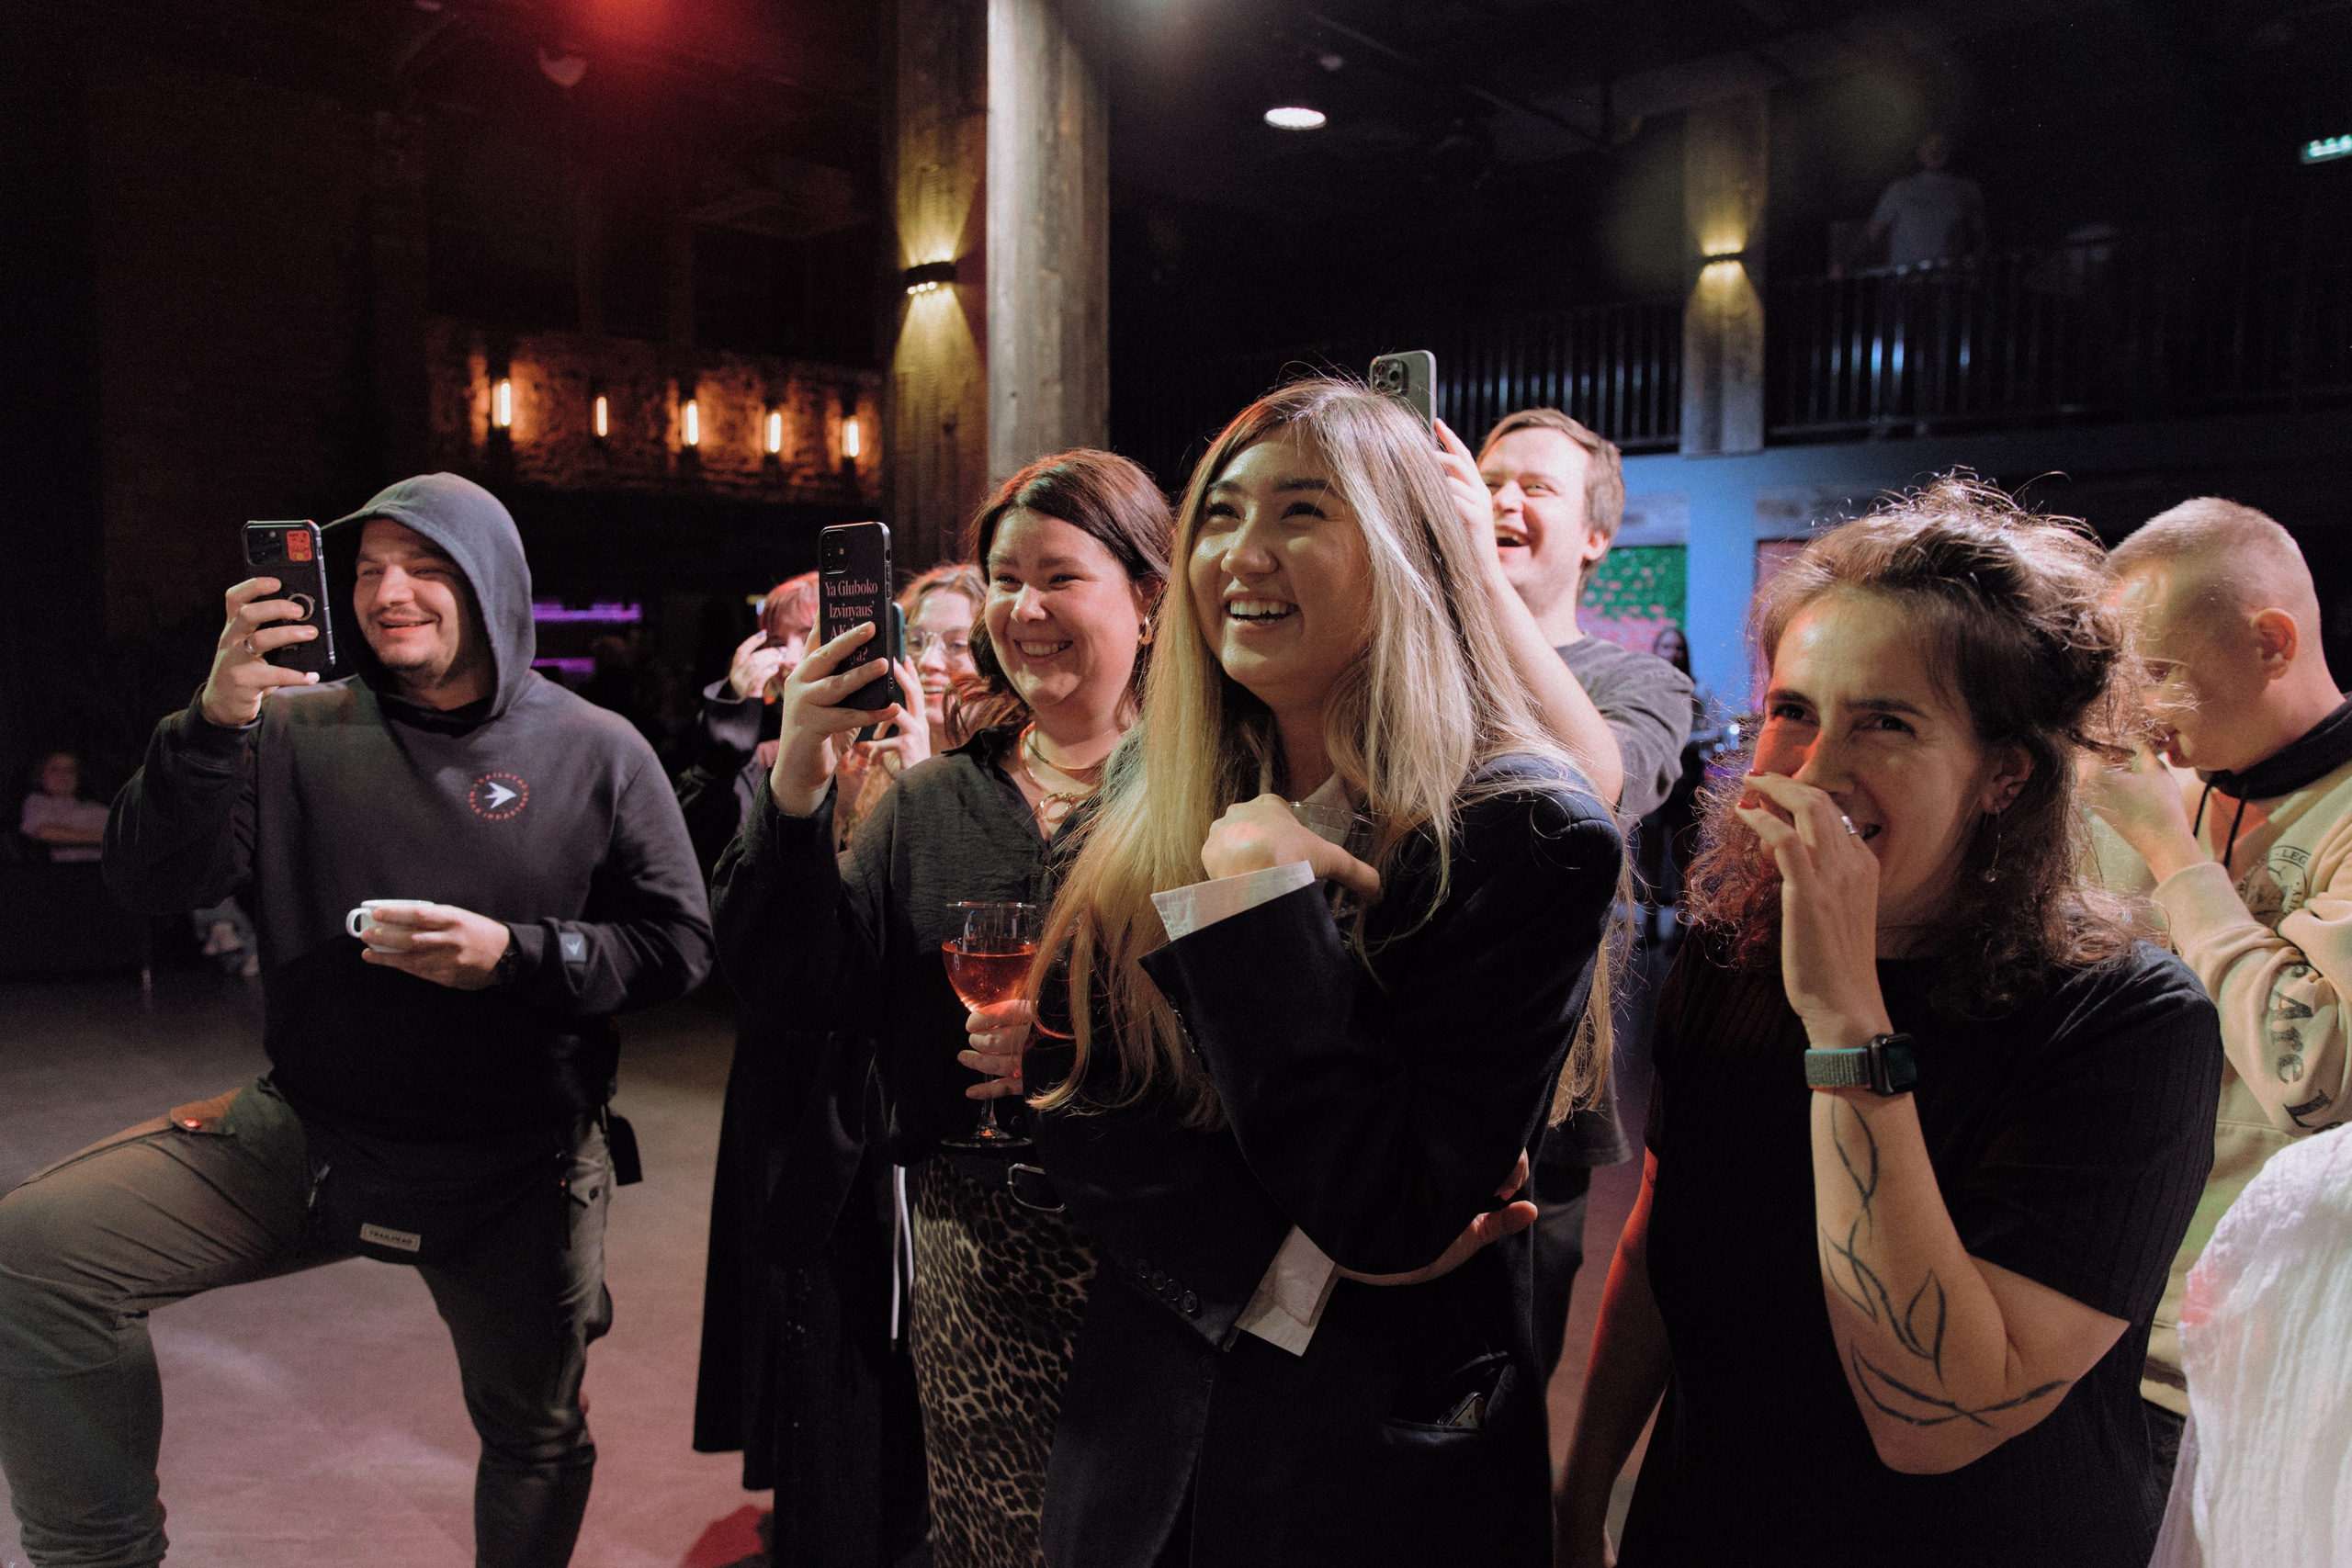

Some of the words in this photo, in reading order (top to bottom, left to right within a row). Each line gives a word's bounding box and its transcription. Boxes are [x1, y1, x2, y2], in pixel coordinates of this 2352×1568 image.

[825, 581, 837, 597] Ya
[838, 579, 878, 596] Gluboko
[2269, 989, 2313, 1084] Are
